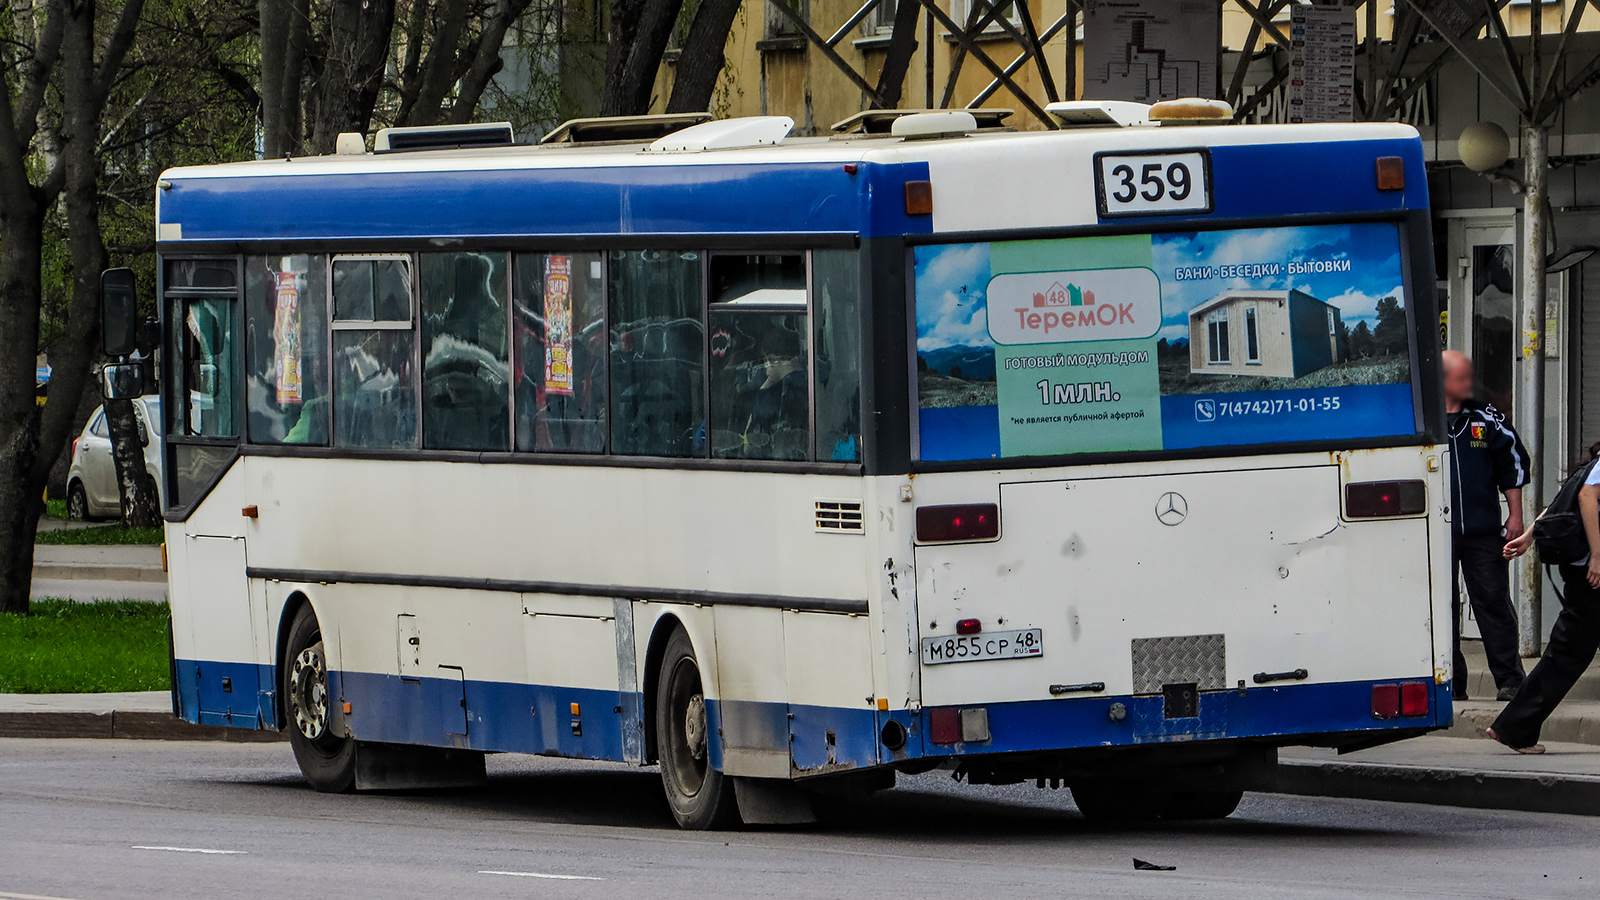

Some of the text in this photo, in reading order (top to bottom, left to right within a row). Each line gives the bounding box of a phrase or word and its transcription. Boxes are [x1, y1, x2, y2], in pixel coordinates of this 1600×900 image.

[1112, 161, 1192, 204] 359
[1176, 259, 1351, 281] БАНИ БЕСЕДКИ БЫТОВКИ
[1049, 290, 1066, 304] 48
[1005, 350, 1149, 370] ГОТОВЫЙ МОДУЛЬДОМ
[1219, 396, 1341, 417] 7(4742)71-01-55
[1026, 415, 1062, 424] является
[1063, 411, 1109, 423] публичной
[1110, 409, 1145, 420] афертой
[1016, 632, 1034, 648] 48
[1014, 647, 1029, 655] RUS
